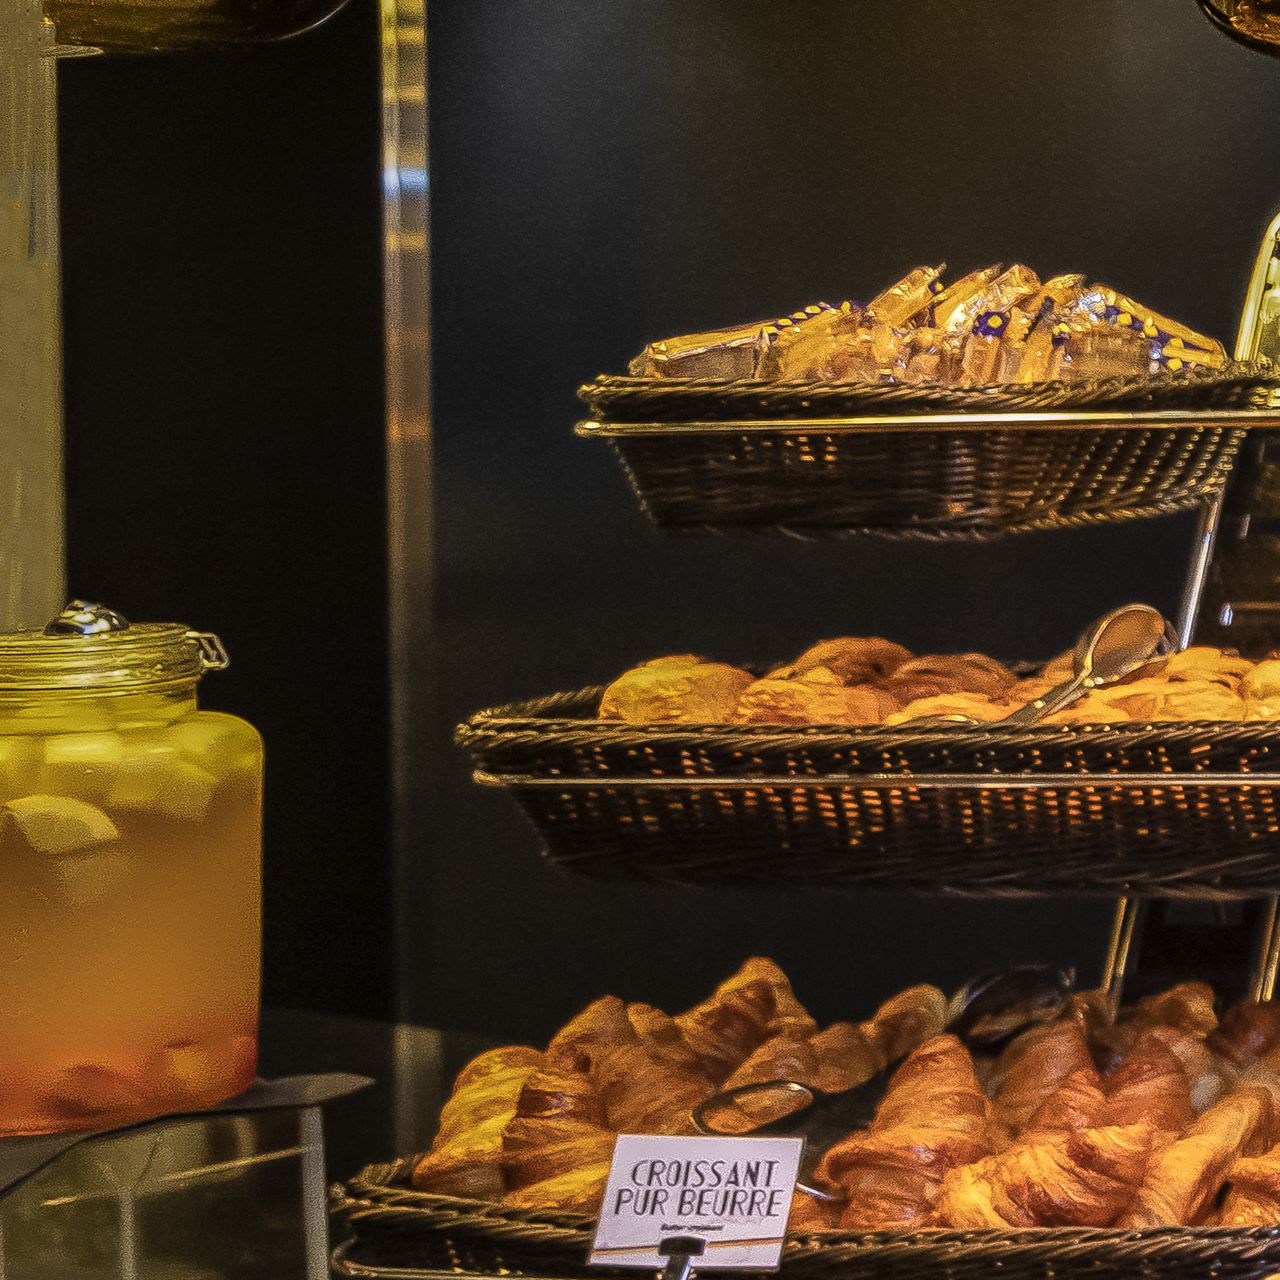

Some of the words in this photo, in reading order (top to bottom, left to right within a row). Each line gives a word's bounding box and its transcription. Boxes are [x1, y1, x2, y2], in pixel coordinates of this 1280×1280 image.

[631, 1160, 780, 1187] CROISSANT
[614, 1188, 669, 1216] PUR
[677, 1189, 785, 1217] BEURRE
